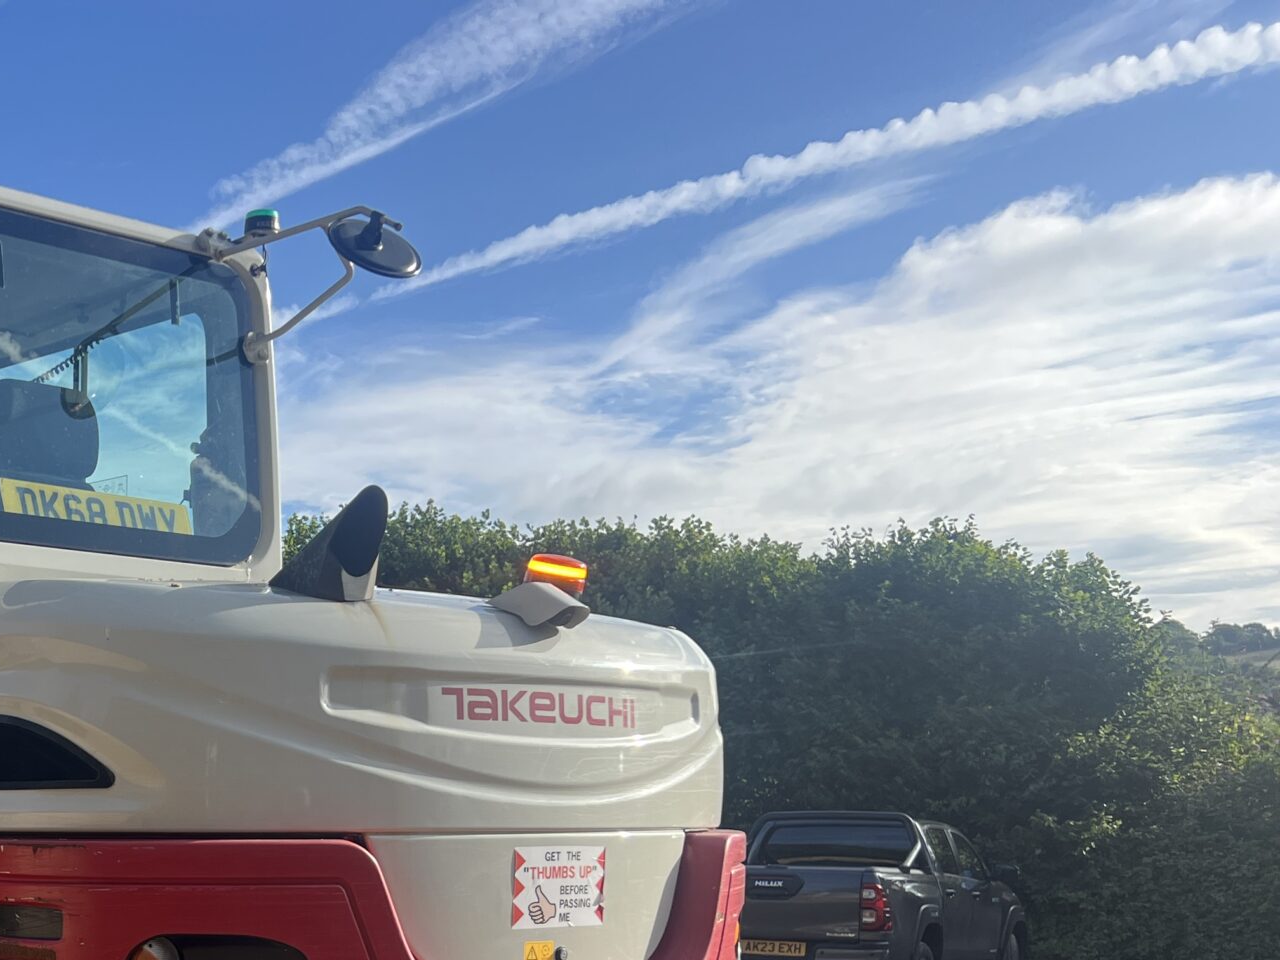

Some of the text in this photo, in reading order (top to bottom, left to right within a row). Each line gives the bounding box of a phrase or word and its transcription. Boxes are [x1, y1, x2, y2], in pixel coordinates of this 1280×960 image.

[15, 486, 108, 525] DK68
[544, 851, 581, 862] GET THE
[559, 884, 588, 895] BEFORE
[558, 898, 591, 909] PASSING
[558, 912, 570, 922] ME
[745, 942, 801, 955] AK23 EXH
